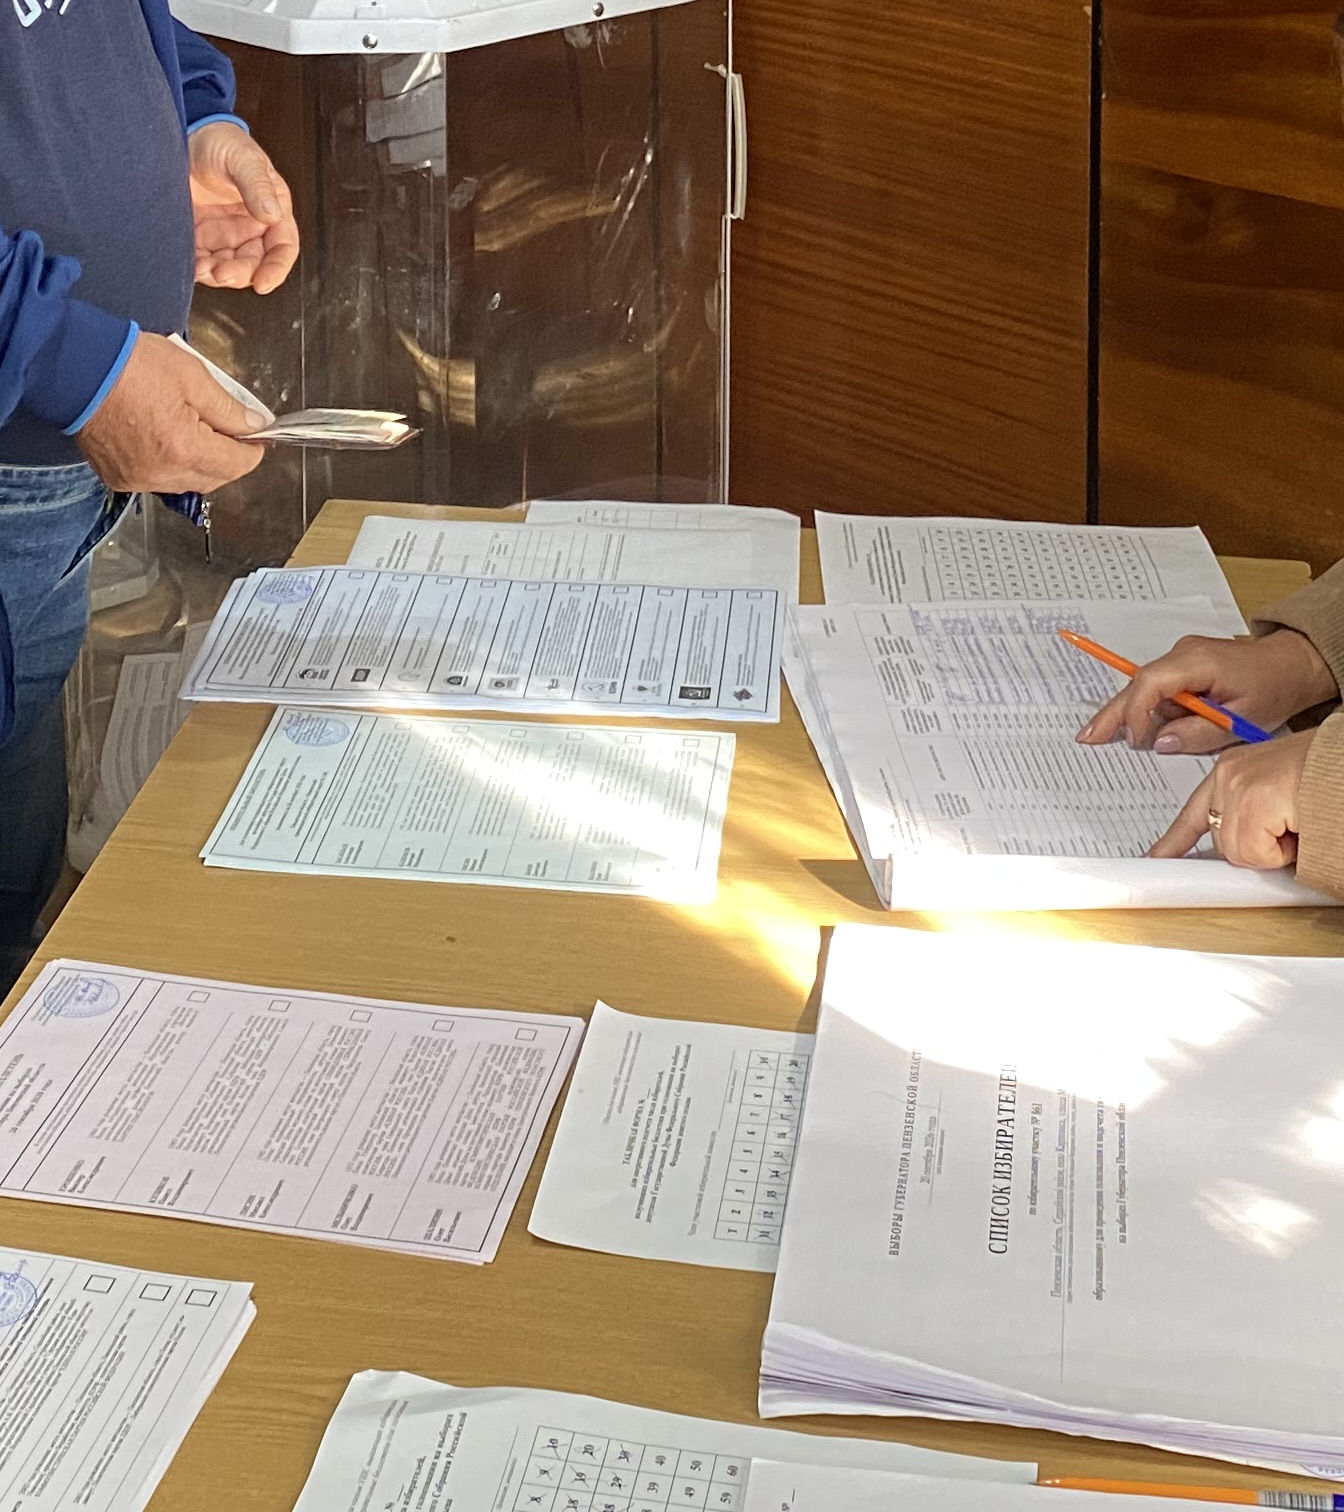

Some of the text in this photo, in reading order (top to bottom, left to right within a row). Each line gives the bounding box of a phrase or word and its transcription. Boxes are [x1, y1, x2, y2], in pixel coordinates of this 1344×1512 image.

[888, 1051, 922, 1256] ВЫБОРЫ ГУБЕРНАТОРА ПЕНЗЕНСКОЙ ОБЛАСТ
[986, 1183, 1013, 1255] СПИСОК
[445, 1412, 467, 1459] Российской
[646, 1453, 667, 1494] 39 40
[682, 1458, 702, 1498] 49 50
[719, 1463, 739, 1504] 59 60
